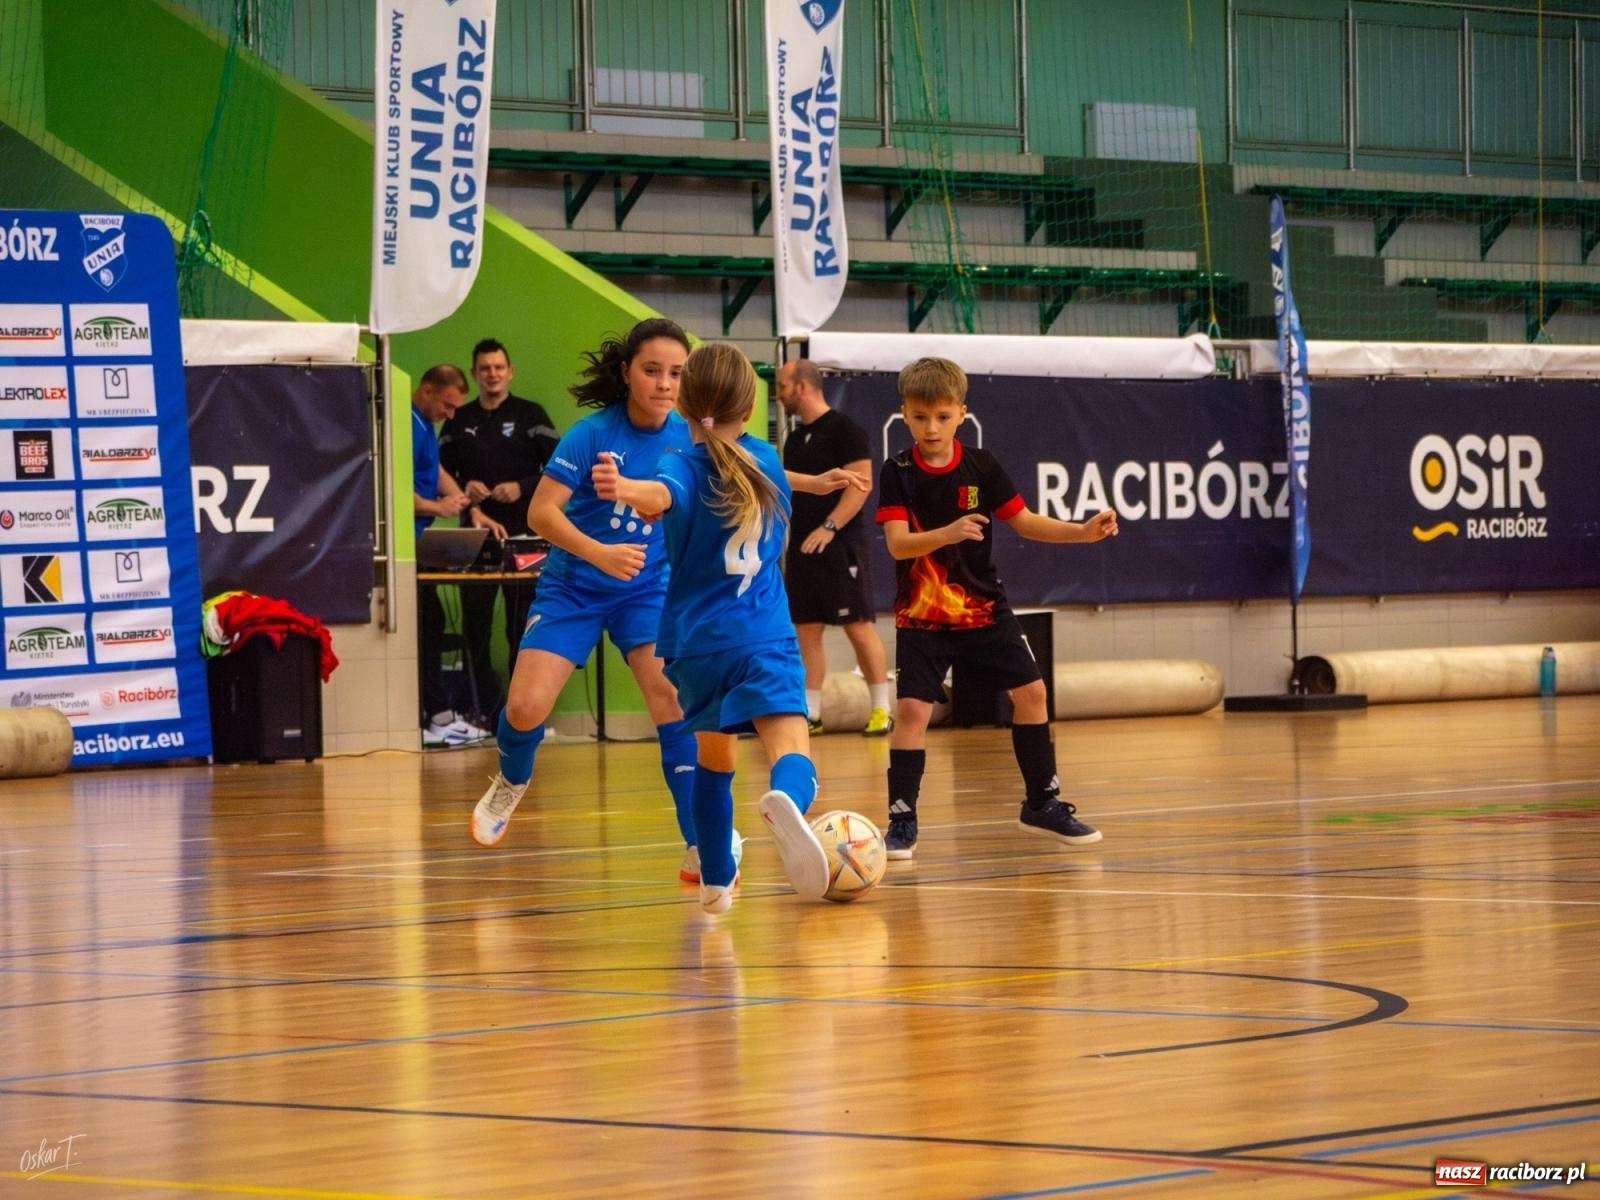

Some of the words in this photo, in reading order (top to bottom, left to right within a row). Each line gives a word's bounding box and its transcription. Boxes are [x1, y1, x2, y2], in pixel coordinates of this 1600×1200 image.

[389, 9, 404, 119] SPORTOWY
[387, 125, 401, 178] KLUB
[410, 62, 447, 219] UNIA
[448, 17, 486, 268] RACIBÓRZ
[790, 88, 815, 231] UNIA
[88, 241, 121, 269] UNIA
[383, 185, 399, 265] MIEJSKI
[19, 445, 48, 456] BEEF
[20, 456, 49, 466] BROS
[19, 511, 52, 521] Marco
[190, 465, 274, 533] RZ
[1466, 512, 1548, 540] RACIBÓRZ
[725, 505, 763, 598] 4
[118, 686, 177, 703] Racibórz
